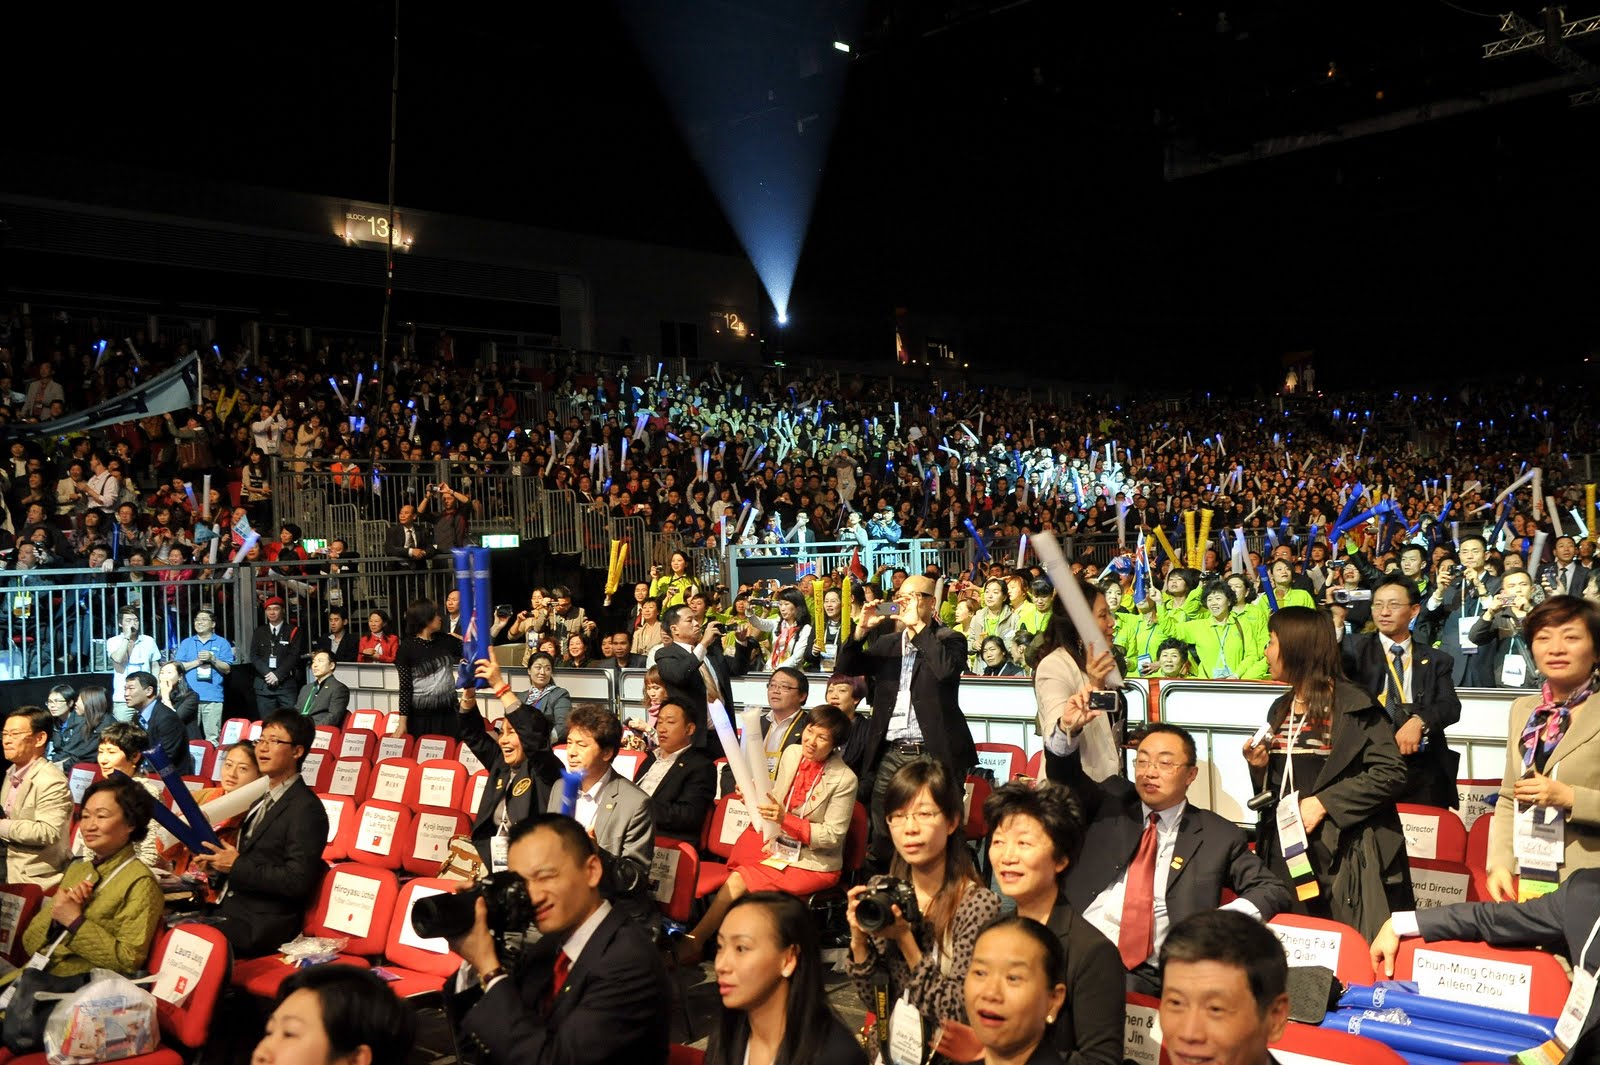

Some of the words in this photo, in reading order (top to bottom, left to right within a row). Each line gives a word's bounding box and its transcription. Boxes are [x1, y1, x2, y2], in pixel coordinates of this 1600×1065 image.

[346, 212, 365, 221] BLOCK
[367, 216, 389, 238] 13
[723, 312, 739, 330] 12
[938, 343, 948, 359] 11
[980, 757, 997, 766] SANA
[1458, 792, 1486, 802] SANA
[1405, 823, 1434, 833] Director
[1428, 882, 1463, 895] Director
[1279, 932, 1311, 949] Zheng
[1315, 937, 1326, 949] Fa
[1294, 949, 1317, 961] Qian
[1417, 957, 1477, 980] Chun-Ming
[1480, 967, 1516, 985] Chang
[1519, 972, 1526, 984] &
[1437, 976, 1473, 991] Aileen
[1475, 982, 1503, 996] Zhou
[877, 991, 886, 1019] Nikon
[1145, 1015, 1154, 1029] &
[1127, 1030, 1144, 1045] Jin
